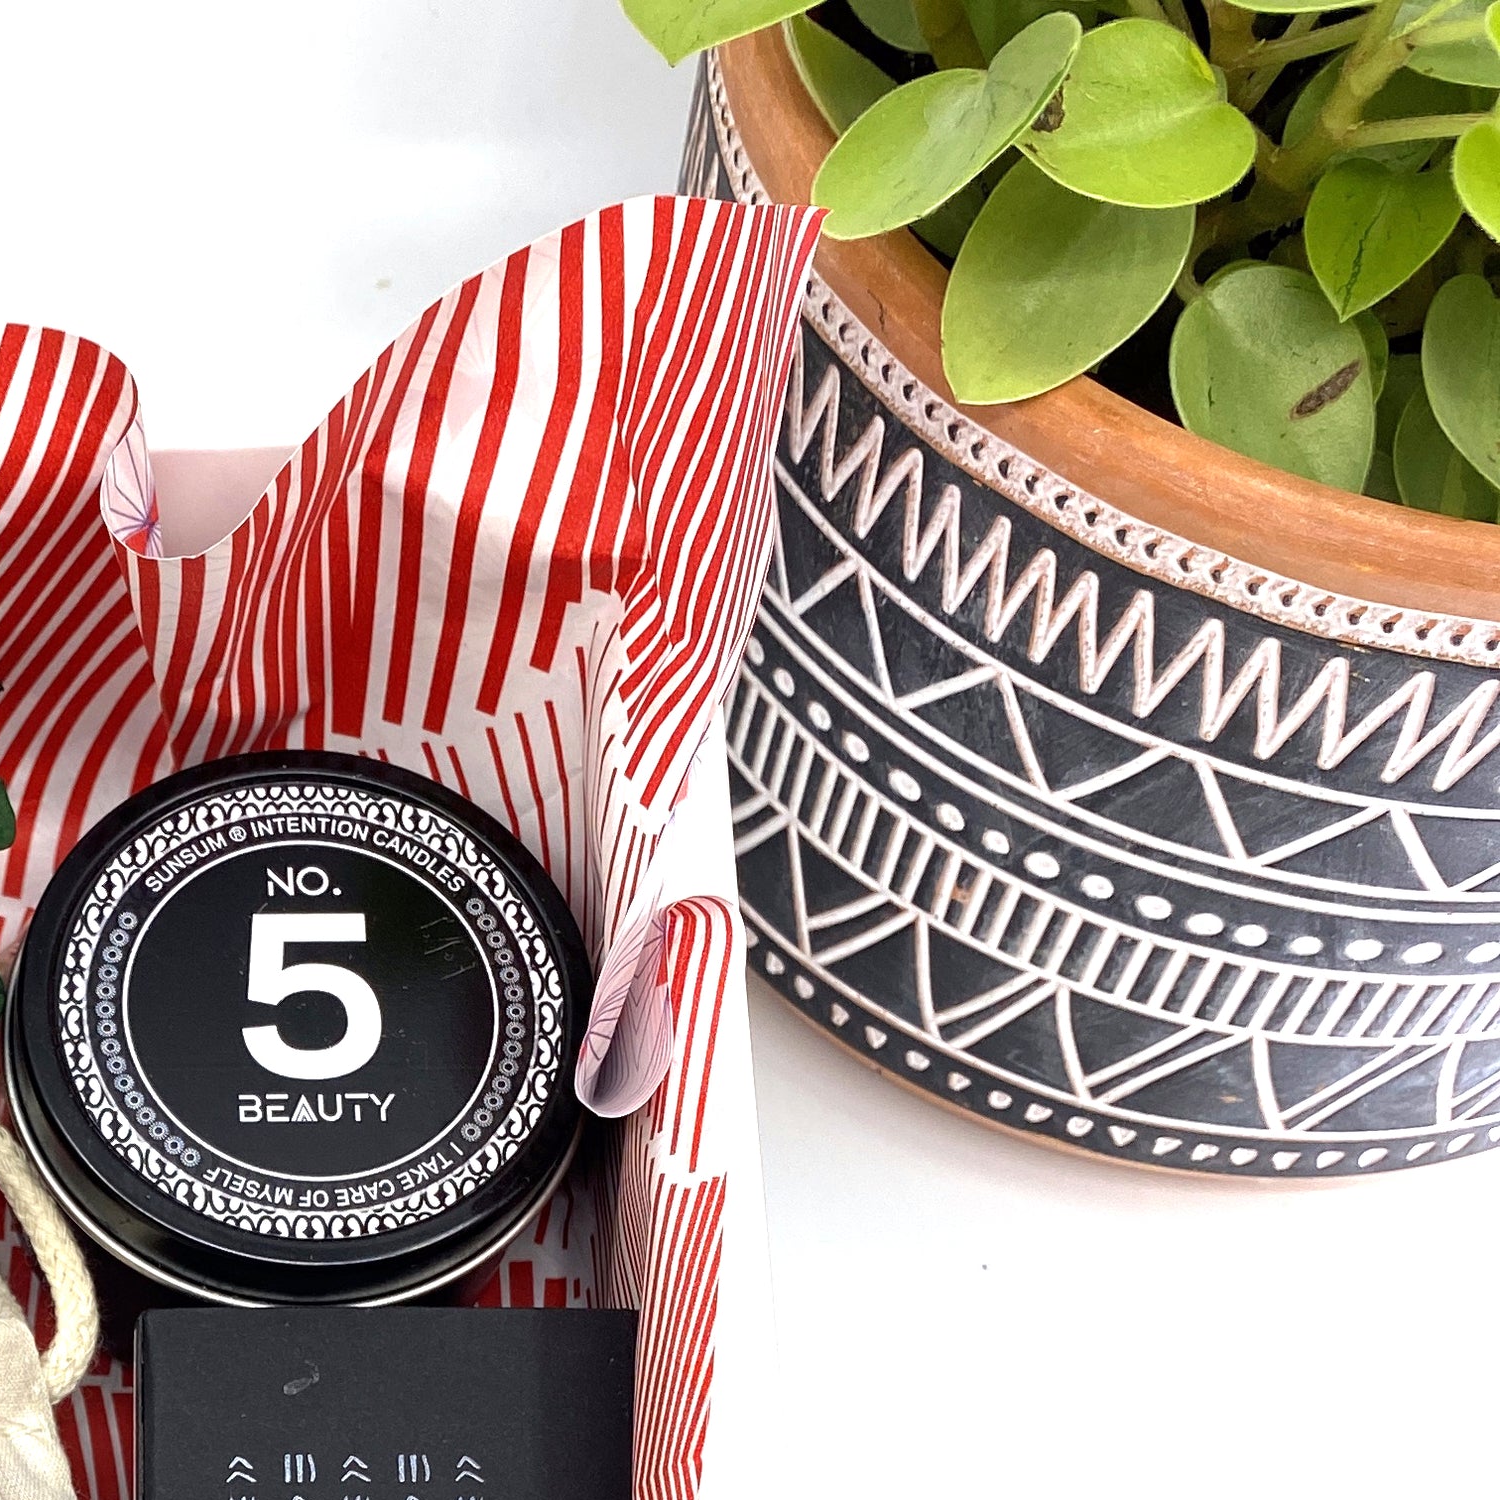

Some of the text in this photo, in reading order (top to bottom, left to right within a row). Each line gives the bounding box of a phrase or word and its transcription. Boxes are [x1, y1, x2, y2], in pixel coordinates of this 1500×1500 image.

[251, 816, 369, 841] INTENTION
[372, 830, 466, 893] CANDLES
[267, 866, 342, 896] NO.
[241, 912, 382, 1080] 5
[238, 1093, 396, 1123] BEAUTY
[202, 1141, 464, 1208] I TAKE CARE OF MYSELF
